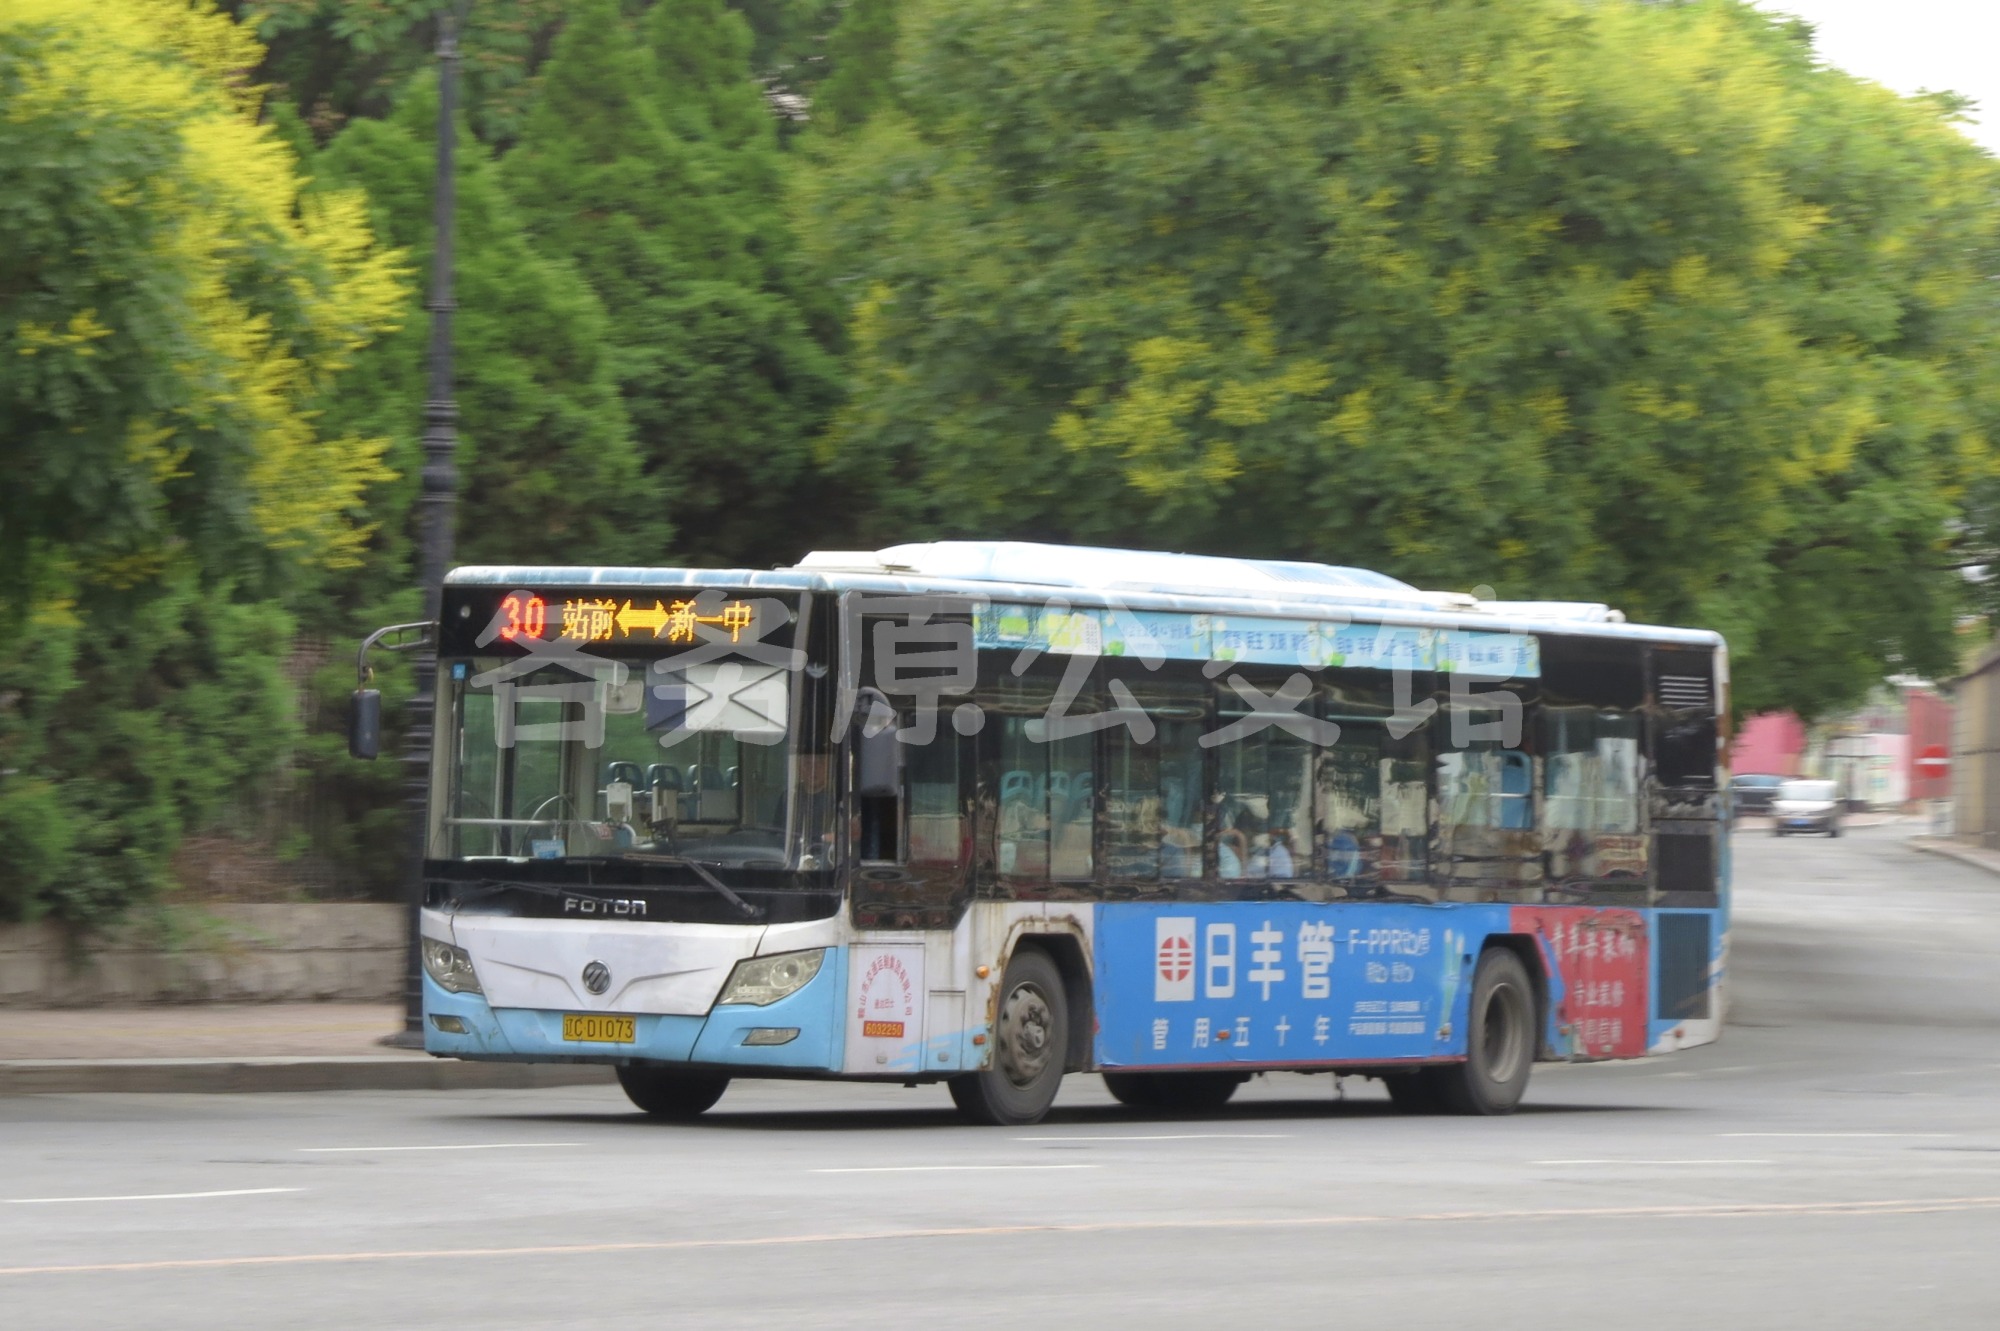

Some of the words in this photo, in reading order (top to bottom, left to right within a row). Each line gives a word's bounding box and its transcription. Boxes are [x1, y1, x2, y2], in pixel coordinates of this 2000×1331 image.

[501, 597, 544, 639] 30
[562, 599, 616, 640] 站前
[668, 600, 752, 643] 新一中
[564, 898, 647, 915] FOTON
[1204, 920, 1335, 1001] 日丰管
[1152, 1014, 1331, 1050] 管用五十年
